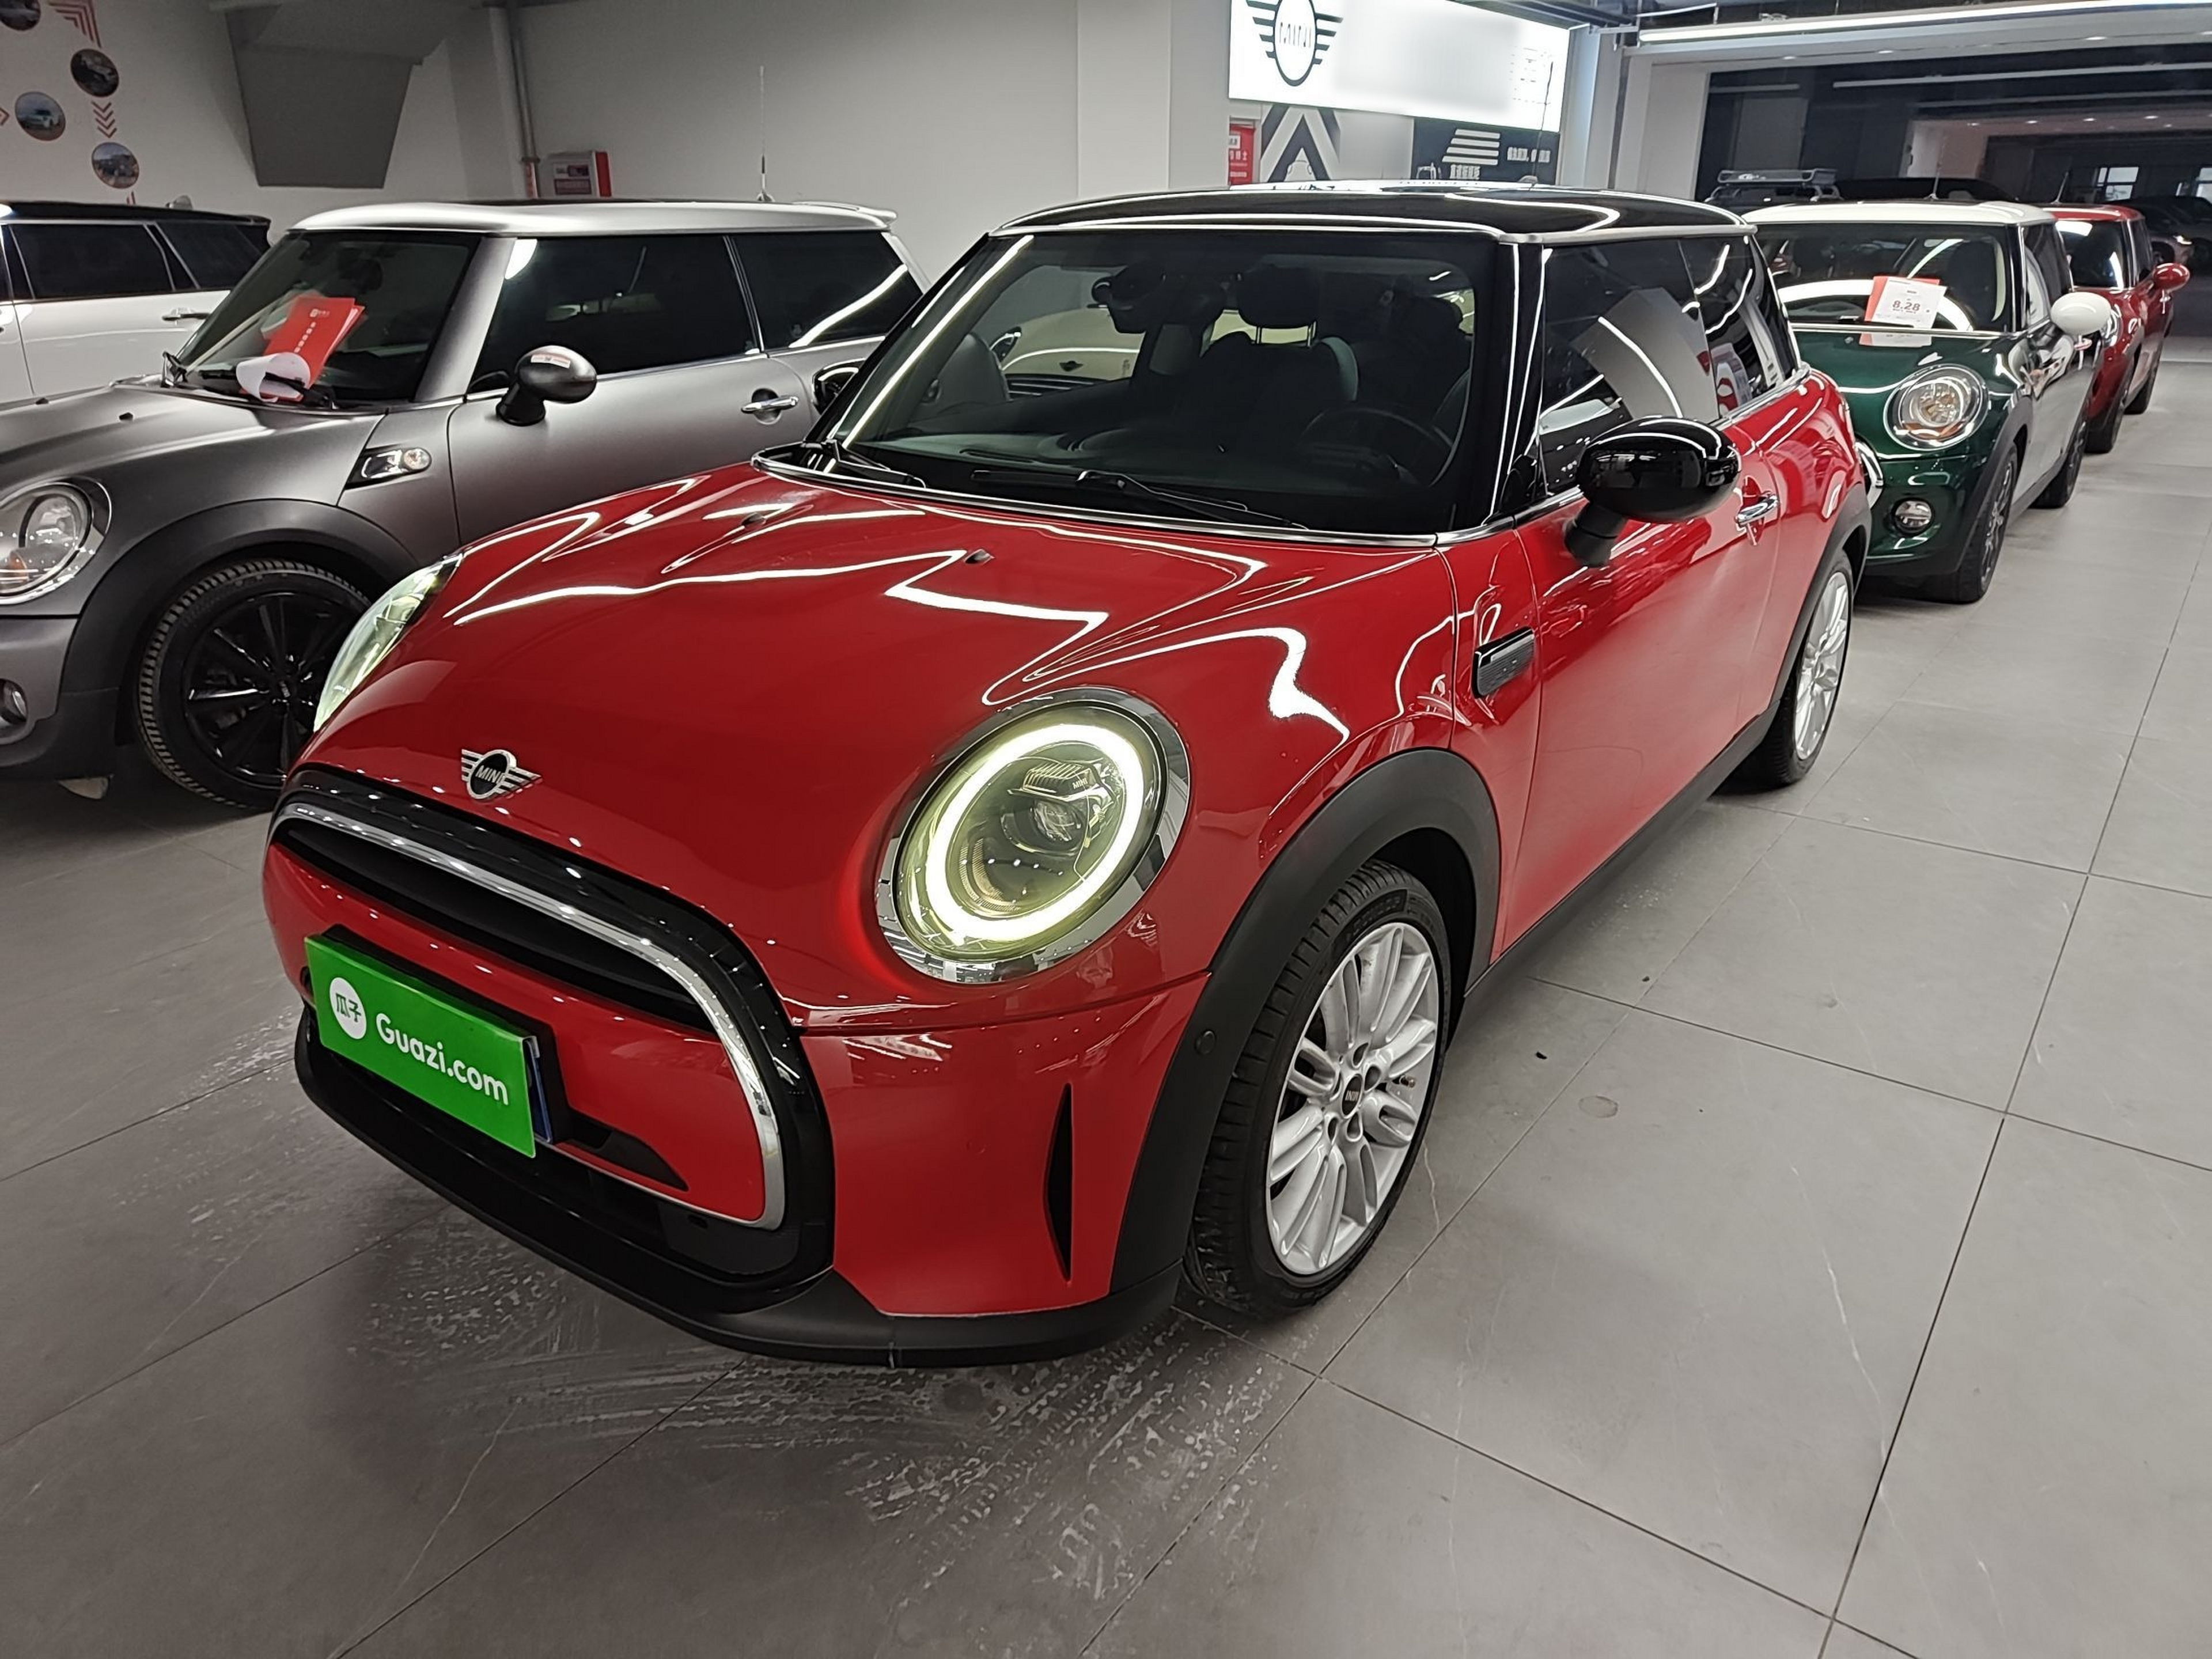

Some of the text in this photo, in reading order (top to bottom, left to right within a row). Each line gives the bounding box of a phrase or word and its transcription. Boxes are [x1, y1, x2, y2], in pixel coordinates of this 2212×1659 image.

[1892, 300, 1921, 312] 8.28
[475, 764, 503, 784] MINI
[1072, 777, 1088, 789] MINI
[335, 993, 509, 1105] 瓜子 Guazi.com
